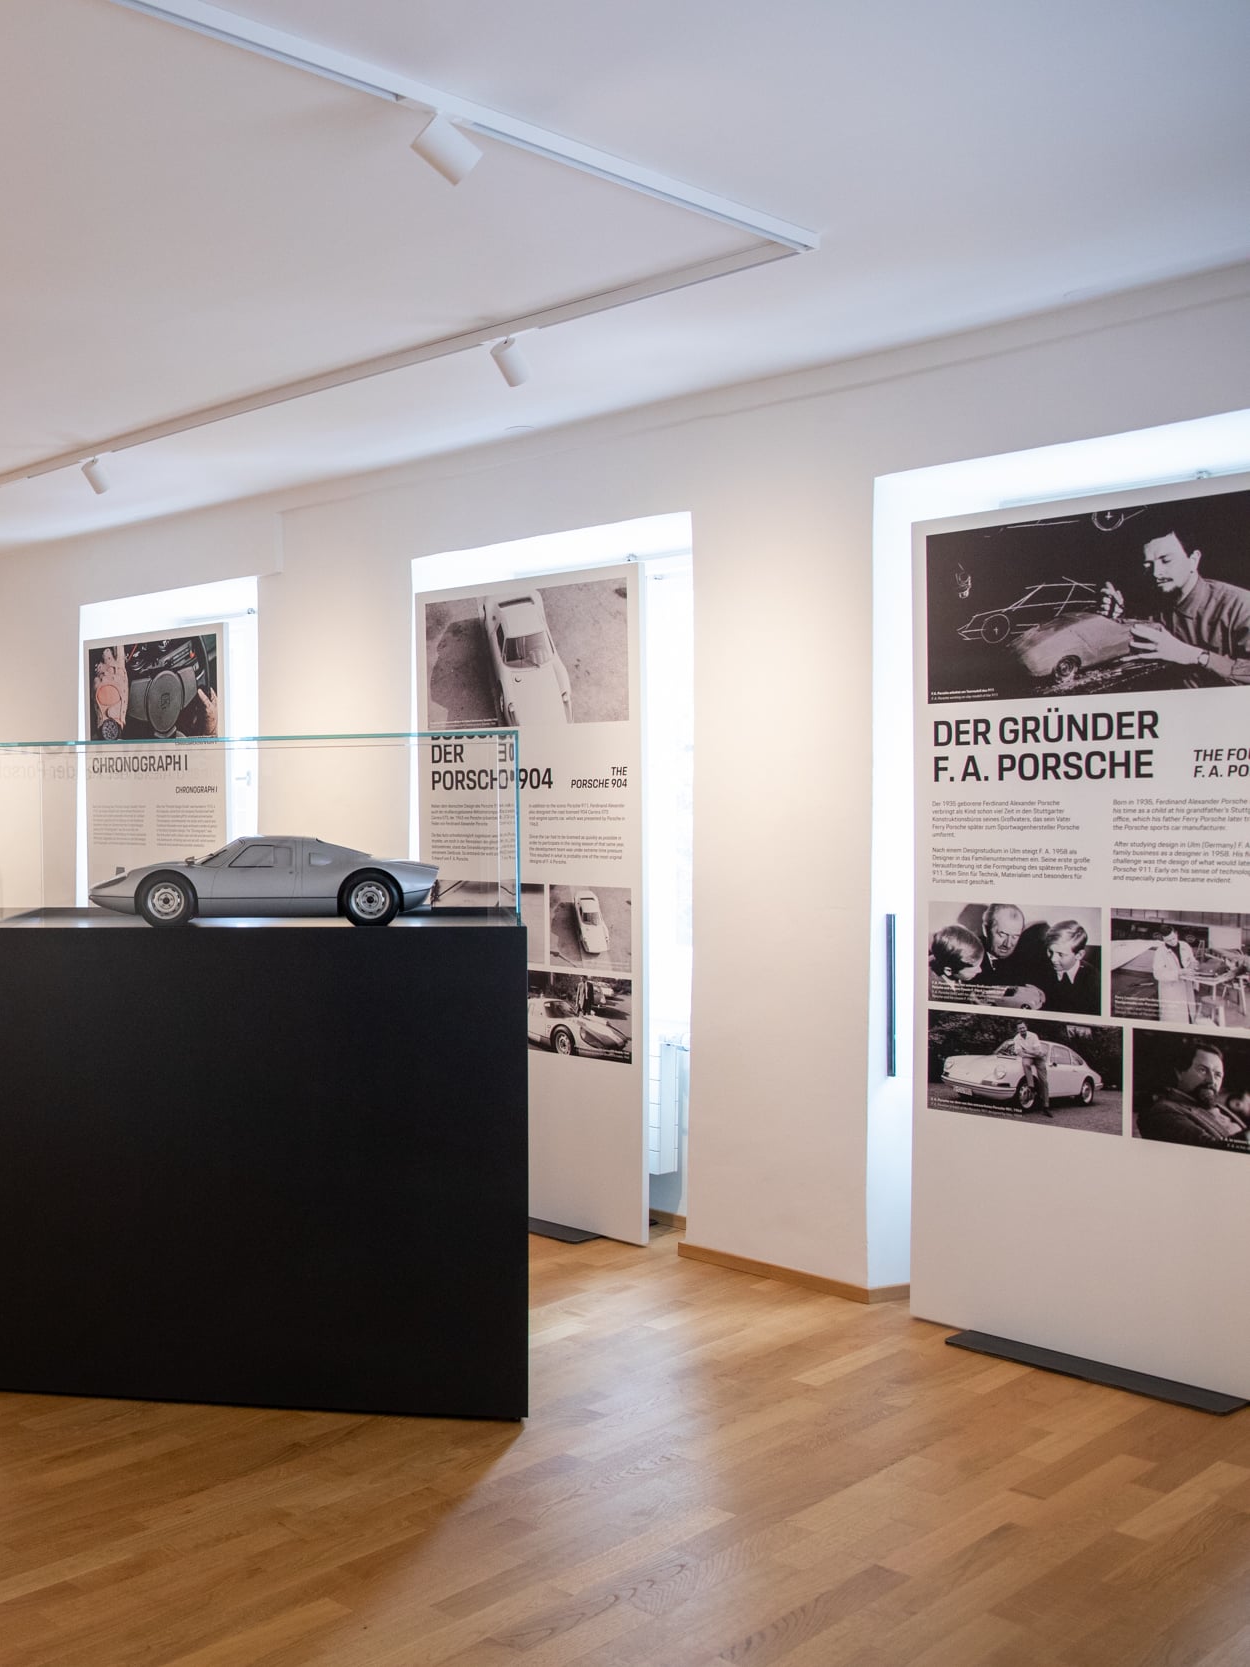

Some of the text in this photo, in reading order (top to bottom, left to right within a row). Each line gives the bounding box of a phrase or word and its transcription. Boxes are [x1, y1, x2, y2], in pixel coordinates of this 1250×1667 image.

[933, 707, 1160, 747] DER GRÜNDER
[431, 744, 464, 764] DER
[1193, 748, 1250, 762] THE FO
[92, 754, 182, 774] CHRONOGRAPH
[611, 766, 628, 776] THE
[933, 750, 1154, 782] F. A. PORSCHE
[1193, 765, 1205, 778] F.
[1208, 765, 1223, 778] A.
[431, 768, 554, 791] PORSCH 904
[570, 778, 628, 789] PORSCHE 904
[176, 786, 214, 794] CHRONOGRAPH
